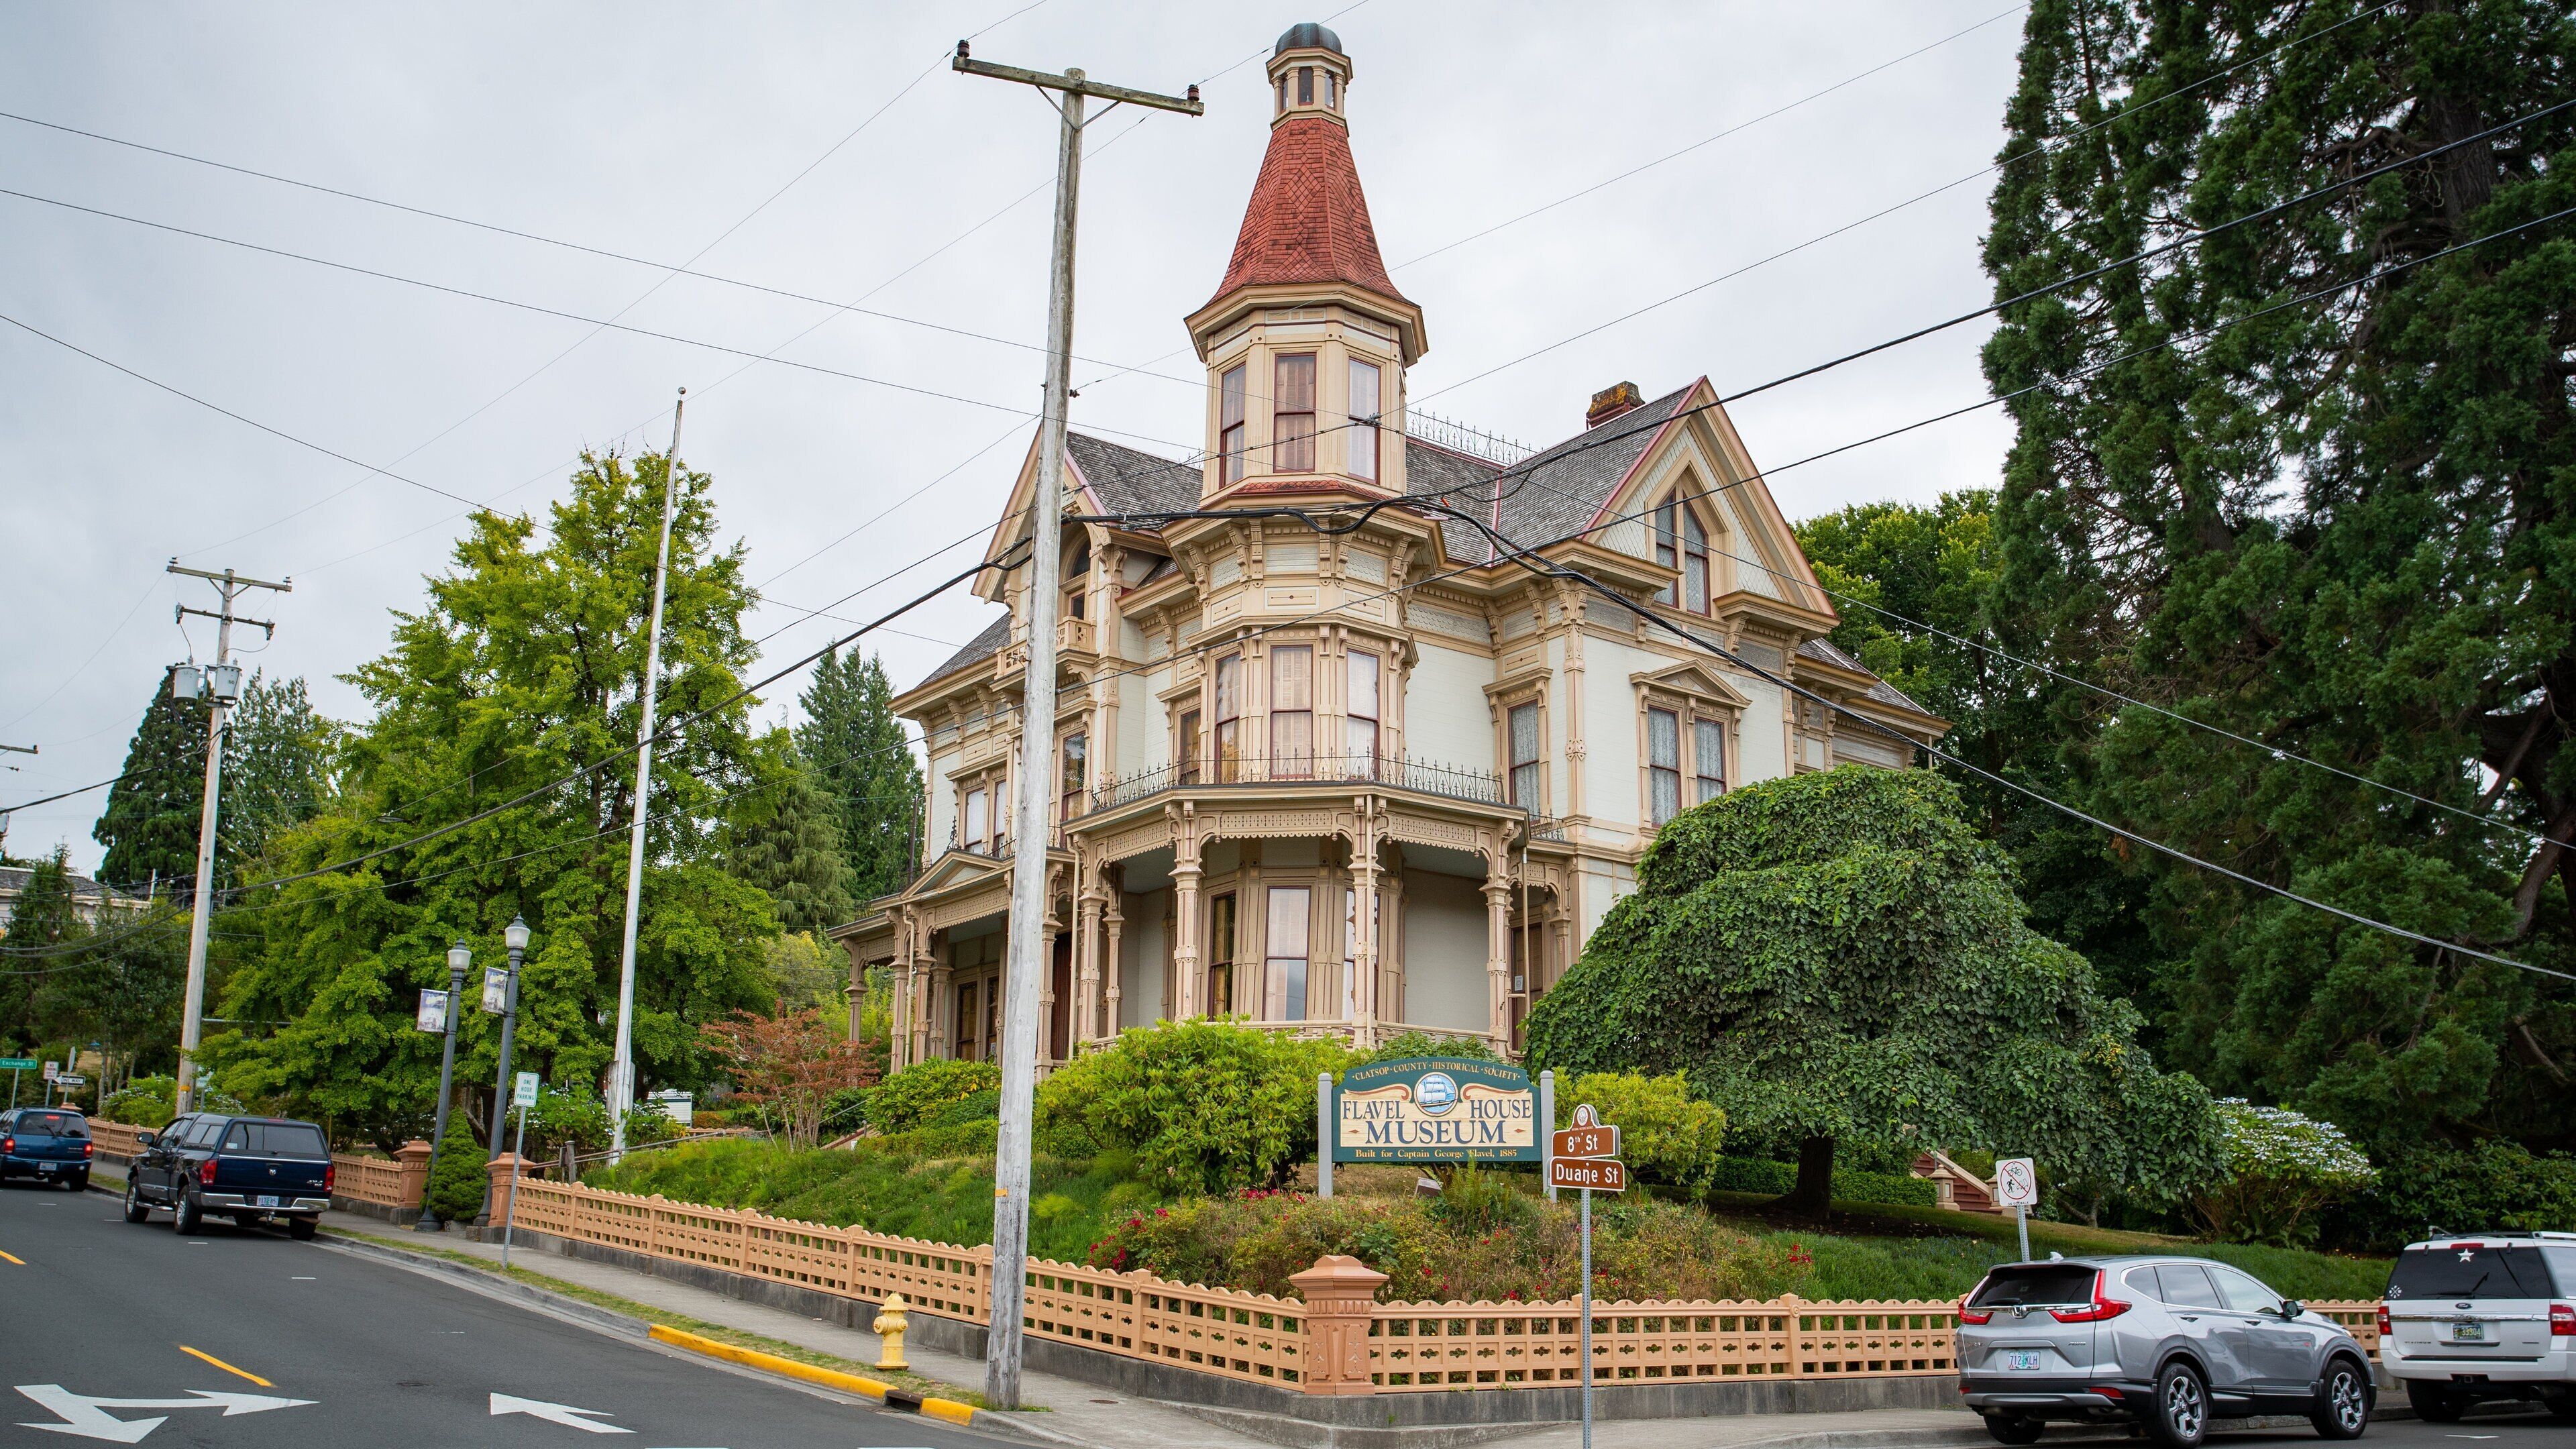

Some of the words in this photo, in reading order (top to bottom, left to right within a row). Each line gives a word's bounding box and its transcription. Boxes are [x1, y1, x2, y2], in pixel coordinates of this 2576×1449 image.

[1355, 1067, 1389, 1081] CLATSOP
[1393, 1062, 1427, 1073] COUNTY
[1432, 1061, 1479, 1073] HISTORICAL
[1483, 1066, 1518, 1081] SOCIETY
[1342, 1100, 1405, 1120] FLAVEL
[1470, 1099, 1532, 1119] HOUSE
[1365, 1120, 1507, 1144] MUSEUM
[1567, 1136, 1580, 1152] 8th
[1586, 1134, 1598, 1150] St
[1356, 1149, 1376, 1158] Built
[1381, 1149, 1393, 1158] for
[1397, 1149, 1430, 1159] Captain
[1434, 1149, 1464, 1159] George
[1499, 1149, 1517, 1157] 1885
[1556, 1163, 1599, 1183] Duane
[1605, 1167, 1619, 1184] St
[2010, 1355, 2021, 1365] 712
[2025, 1355, 2038, 1365] KLH
